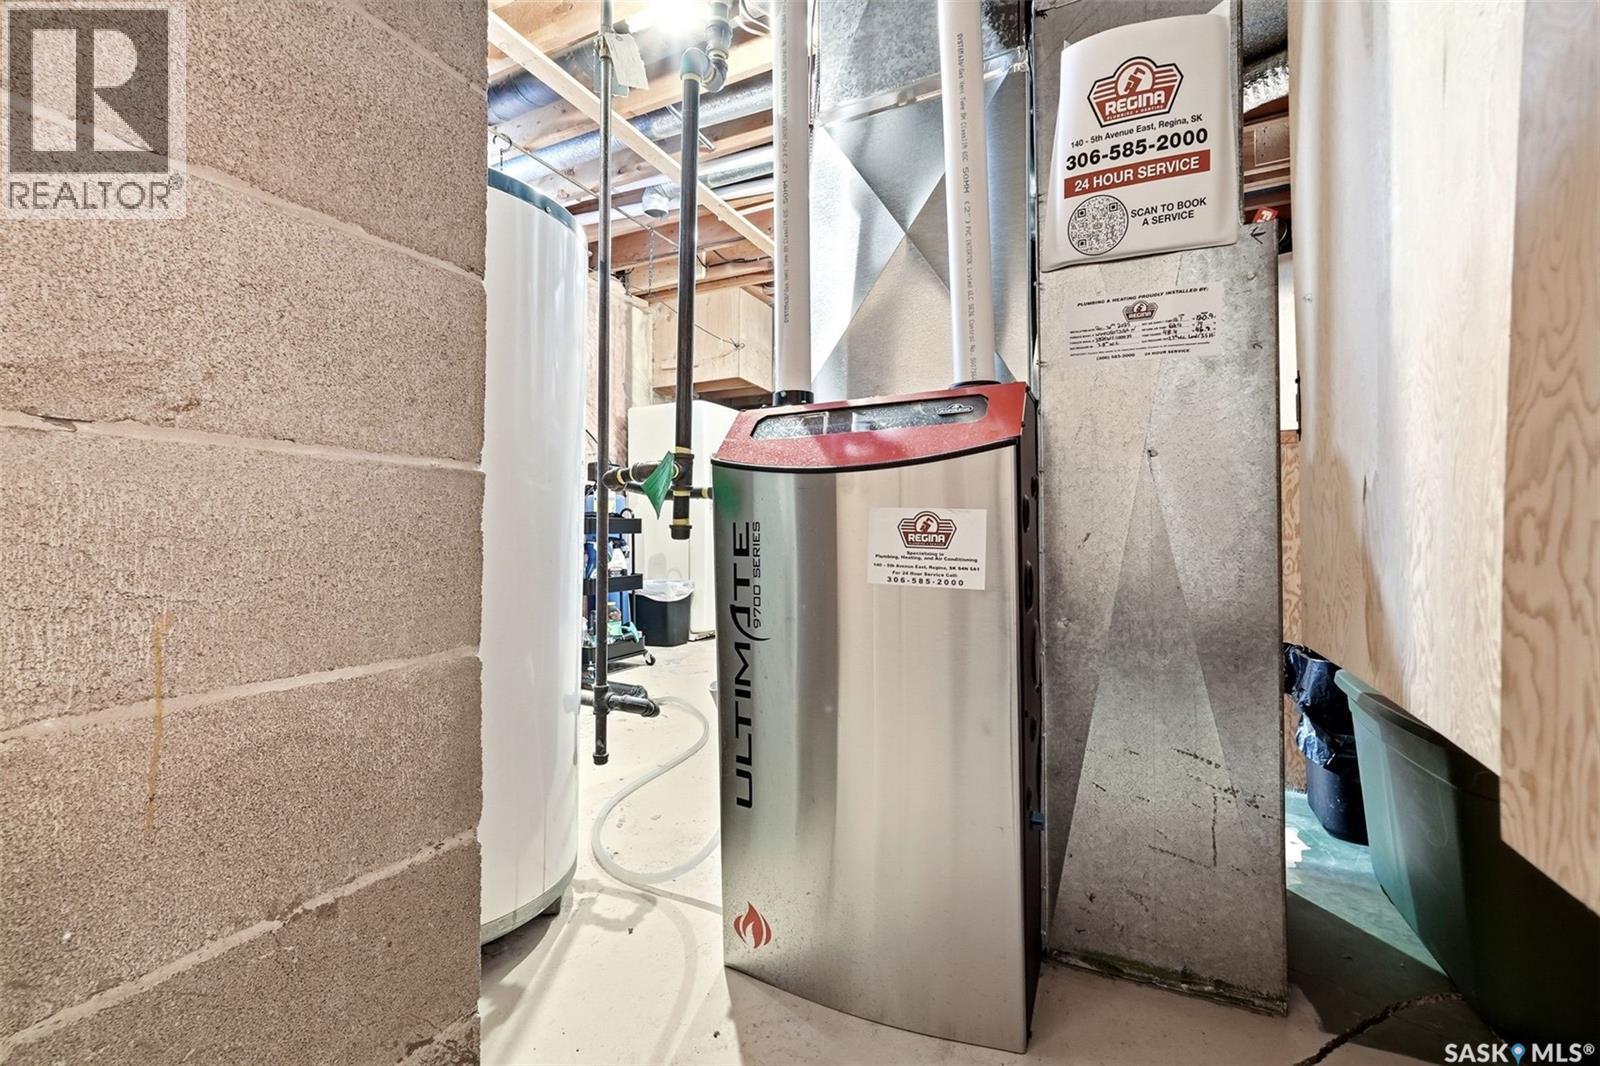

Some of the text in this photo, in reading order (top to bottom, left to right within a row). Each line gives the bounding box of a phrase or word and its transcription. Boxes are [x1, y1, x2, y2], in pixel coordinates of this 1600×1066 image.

[1105, 90, 1165, 116] REGINA
[1071, 140, 1083, 149] 140
[1091, 134, 1103, 143] 5th
[1105, 128, 1133, 140] Avenue
[1136, 123, 1156, 135] East,
[1158, 117, 1189, 130] Regina,
[1191, 113, 1203, 122] SK
[1066, 128, 1208, 170] 306-585-2000
[1074, 157, 1199, 192] 24 HOUR SERVICE
[1131, 197, 1207, 218] SCAN TO BOOK
[1142, 210, 1195, 226] A SERVICE
[908, 533, 945, 542] REGINA
[752, 521, 762, 629] 9700 SERIES
[730, 521, 767, 809] ULTIMATE
